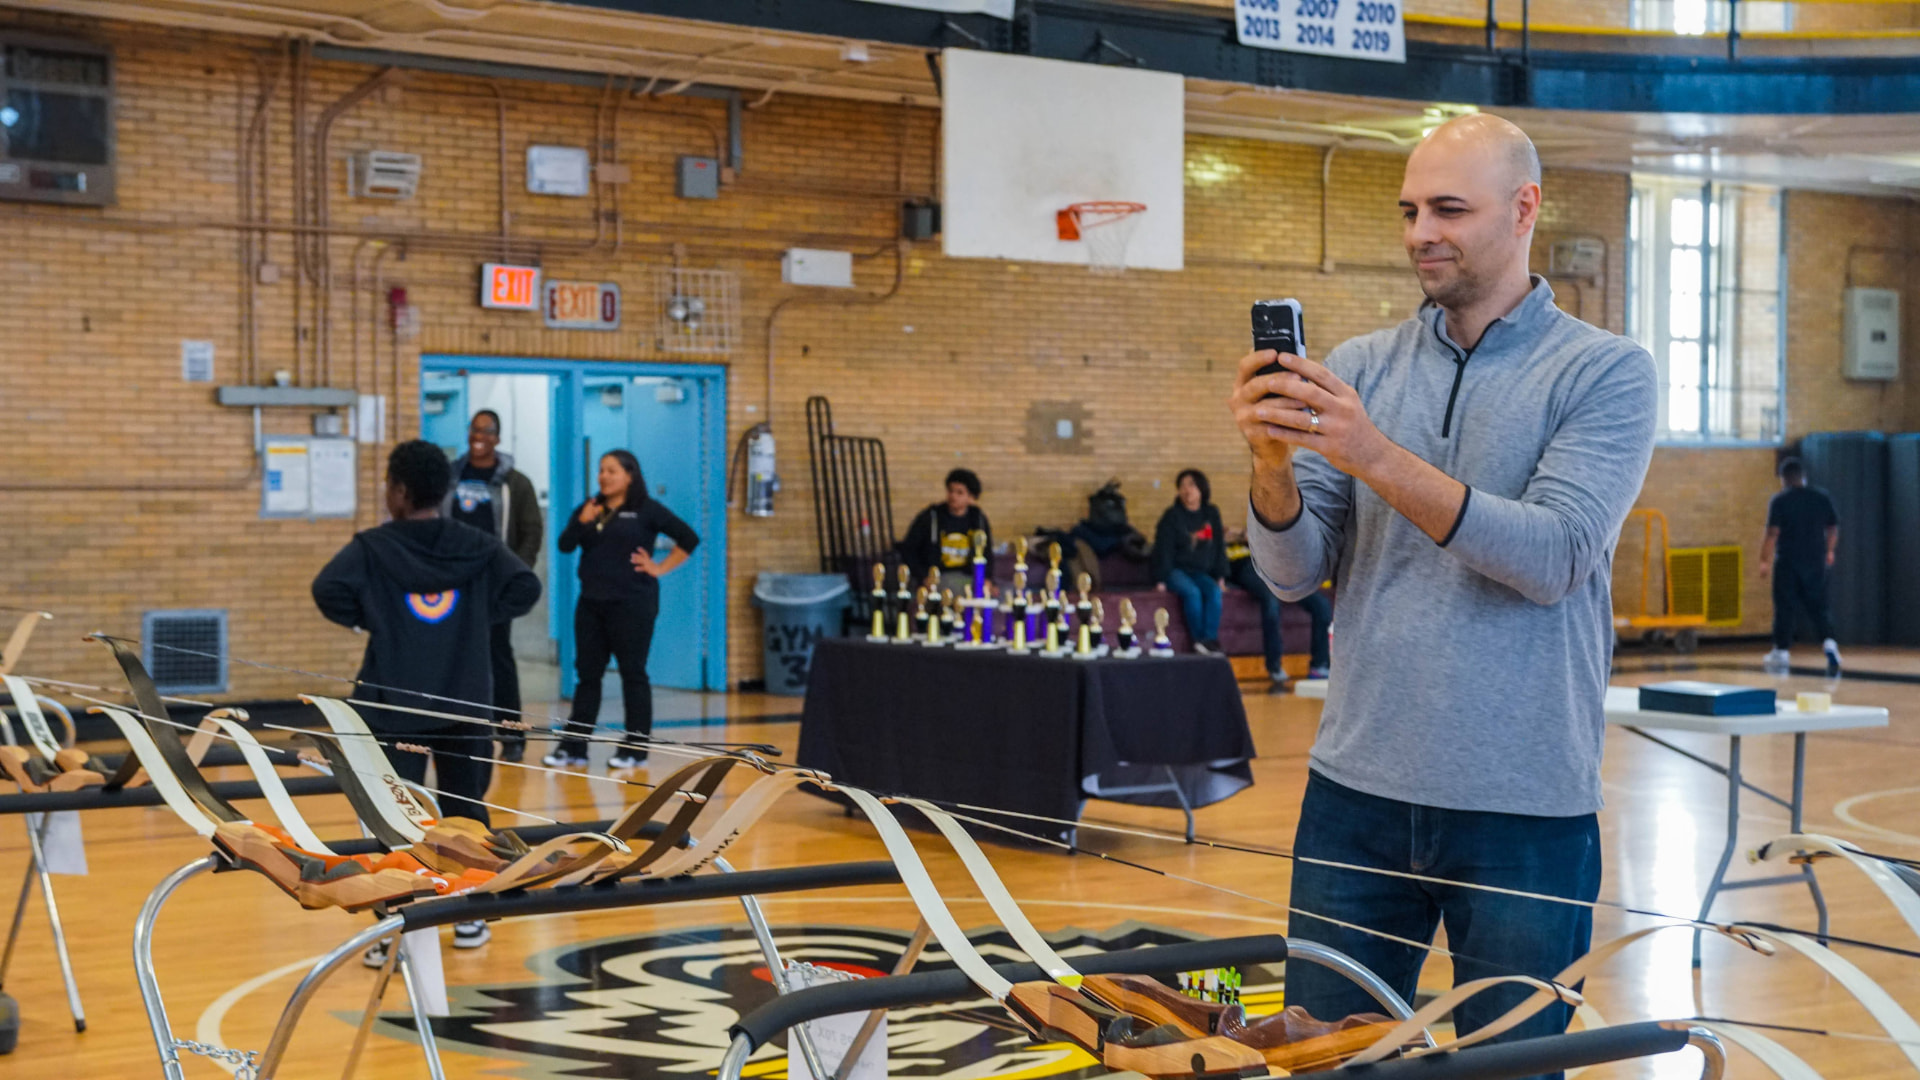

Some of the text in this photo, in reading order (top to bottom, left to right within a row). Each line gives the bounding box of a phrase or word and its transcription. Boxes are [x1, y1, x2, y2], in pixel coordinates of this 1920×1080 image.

[1296, 0, 1338, 18] 2007
[1356, 2, 1395, 24] 2010
[1244, 15, 1390, 51] 2013 2014 2019
[492, 266, 536, 306] EXIT
[557, 283, 599, 320] EXIT
[781, 654, 808, 688] 3
